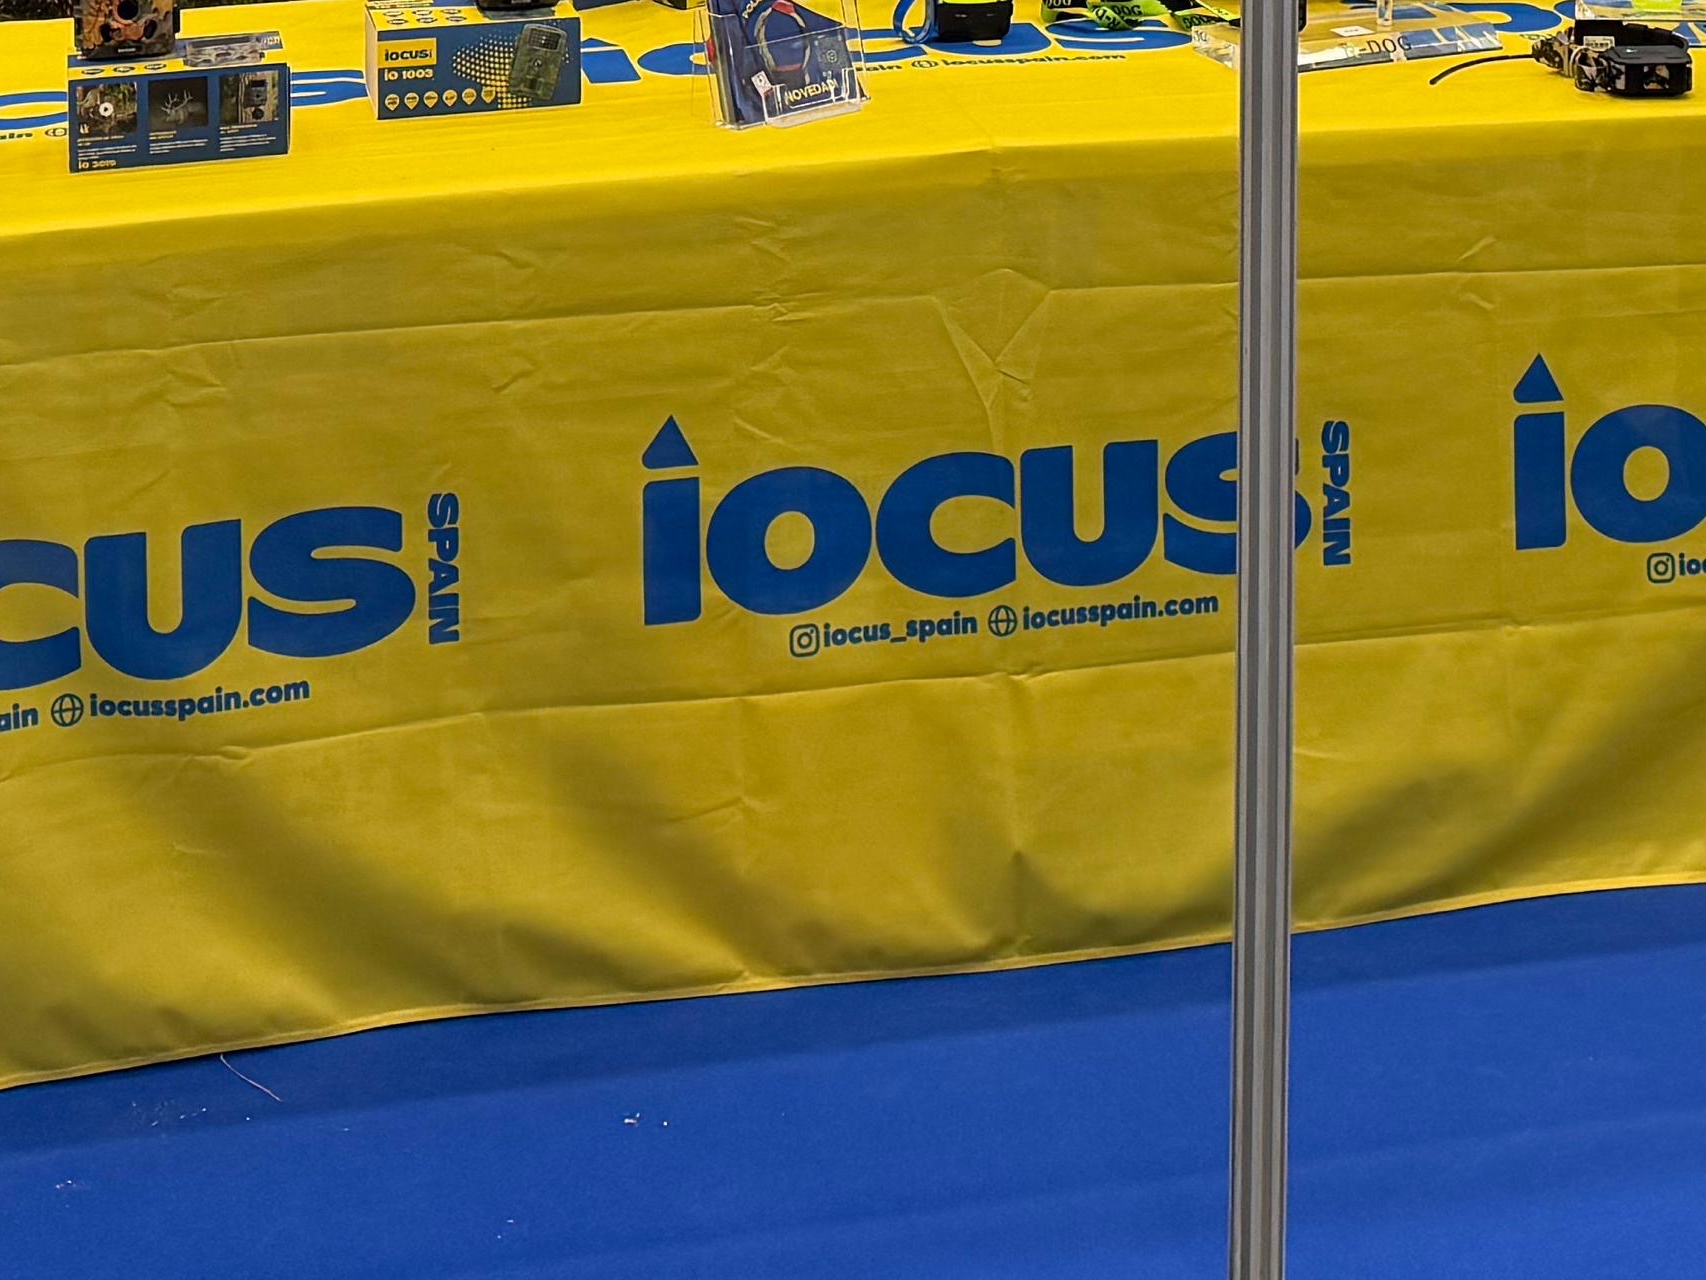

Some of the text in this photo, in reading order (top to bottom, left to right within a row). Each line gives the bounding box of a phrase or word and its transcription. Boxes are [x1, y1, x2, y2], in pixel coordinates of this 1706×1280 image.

[1320, 419, 1351, 566] SPAIN
[426, 491, 460, 645] SPAIN
[823, 592, 1219, 648] iocus_spain iocusspain.com
[89, 677, 311, 719] iocusspain.com
